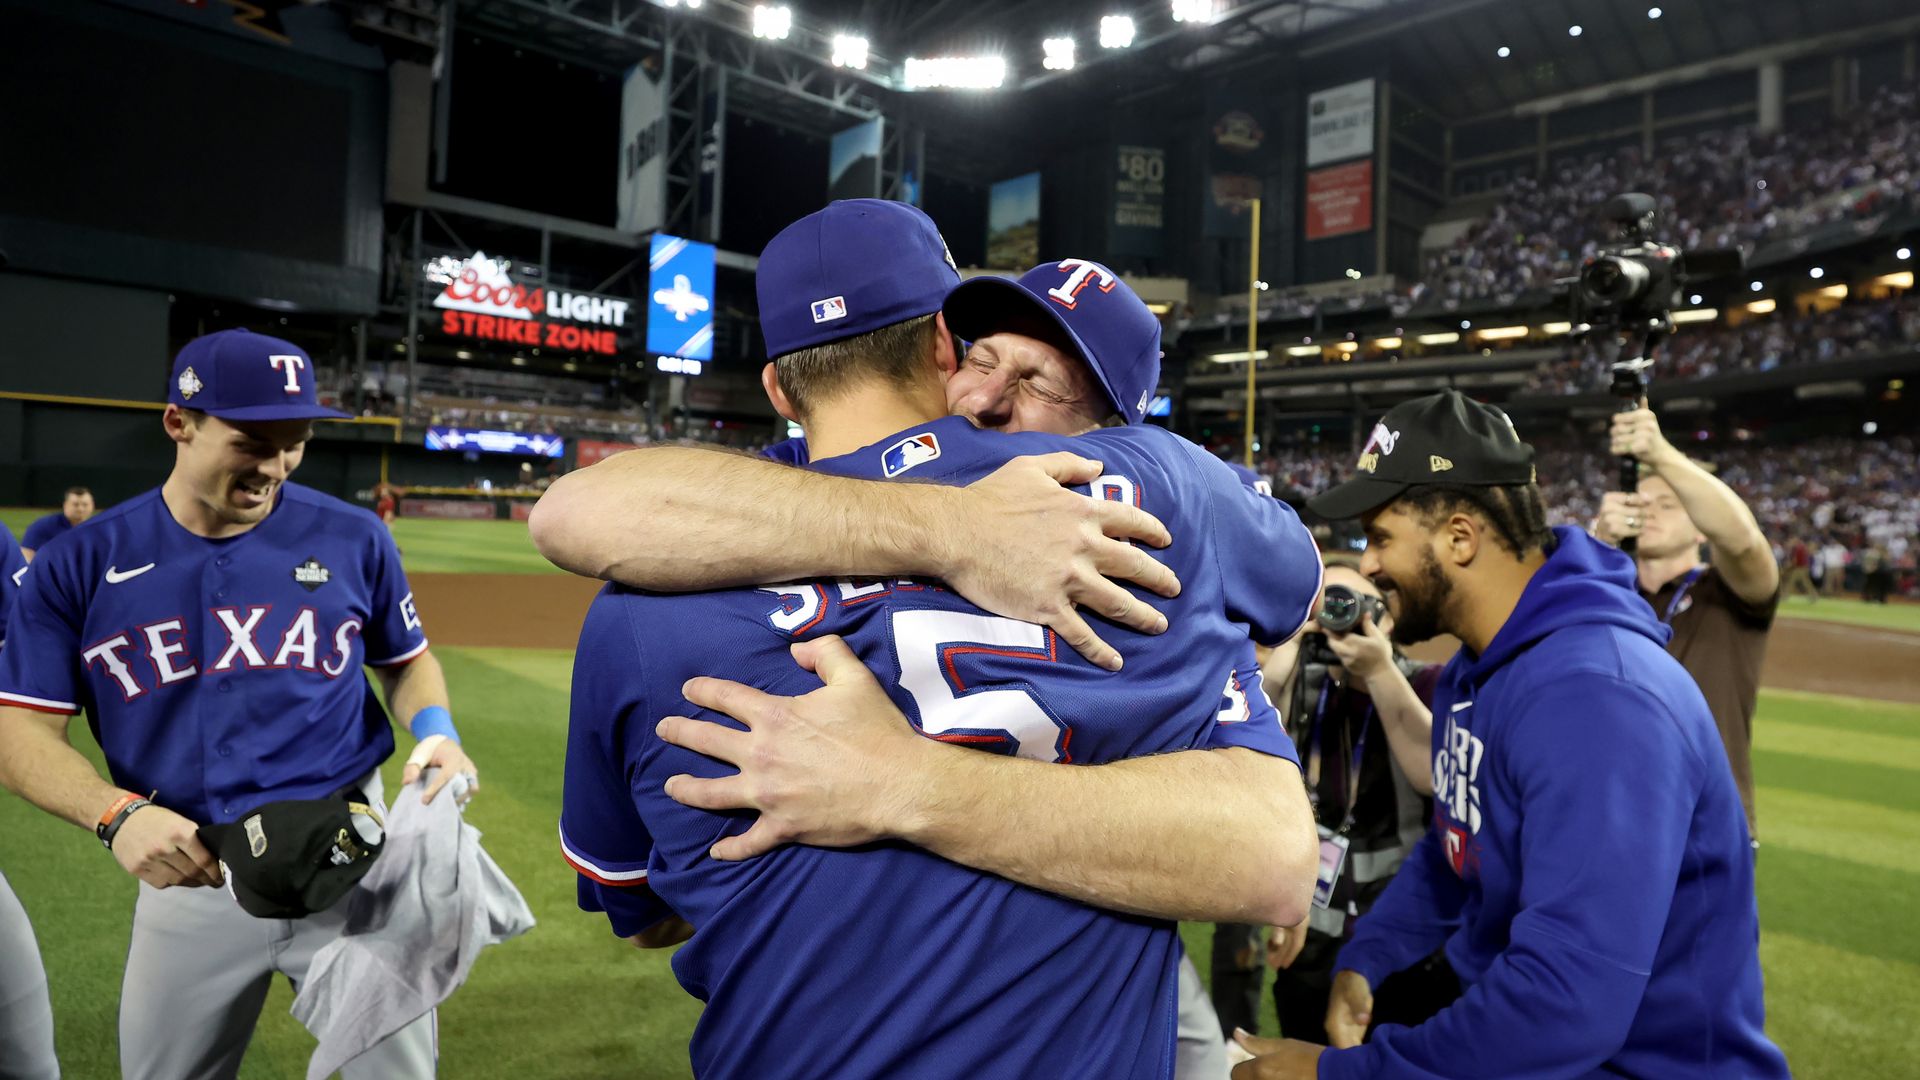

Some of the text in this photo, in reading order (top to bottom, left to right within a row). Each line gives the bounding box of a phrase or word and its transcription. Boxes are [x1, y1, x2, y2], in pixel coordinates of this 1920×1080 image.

[445, 267, 629, 326] Coors LIGHT
[1048, 258, 1117, 311] T
[442, 311, 618, 355] STRIKE ZONE
[268, 354, 305, 395] T
[81, 605, 363, 702] TEXAS
[887, 608, 1073, 764] 5
